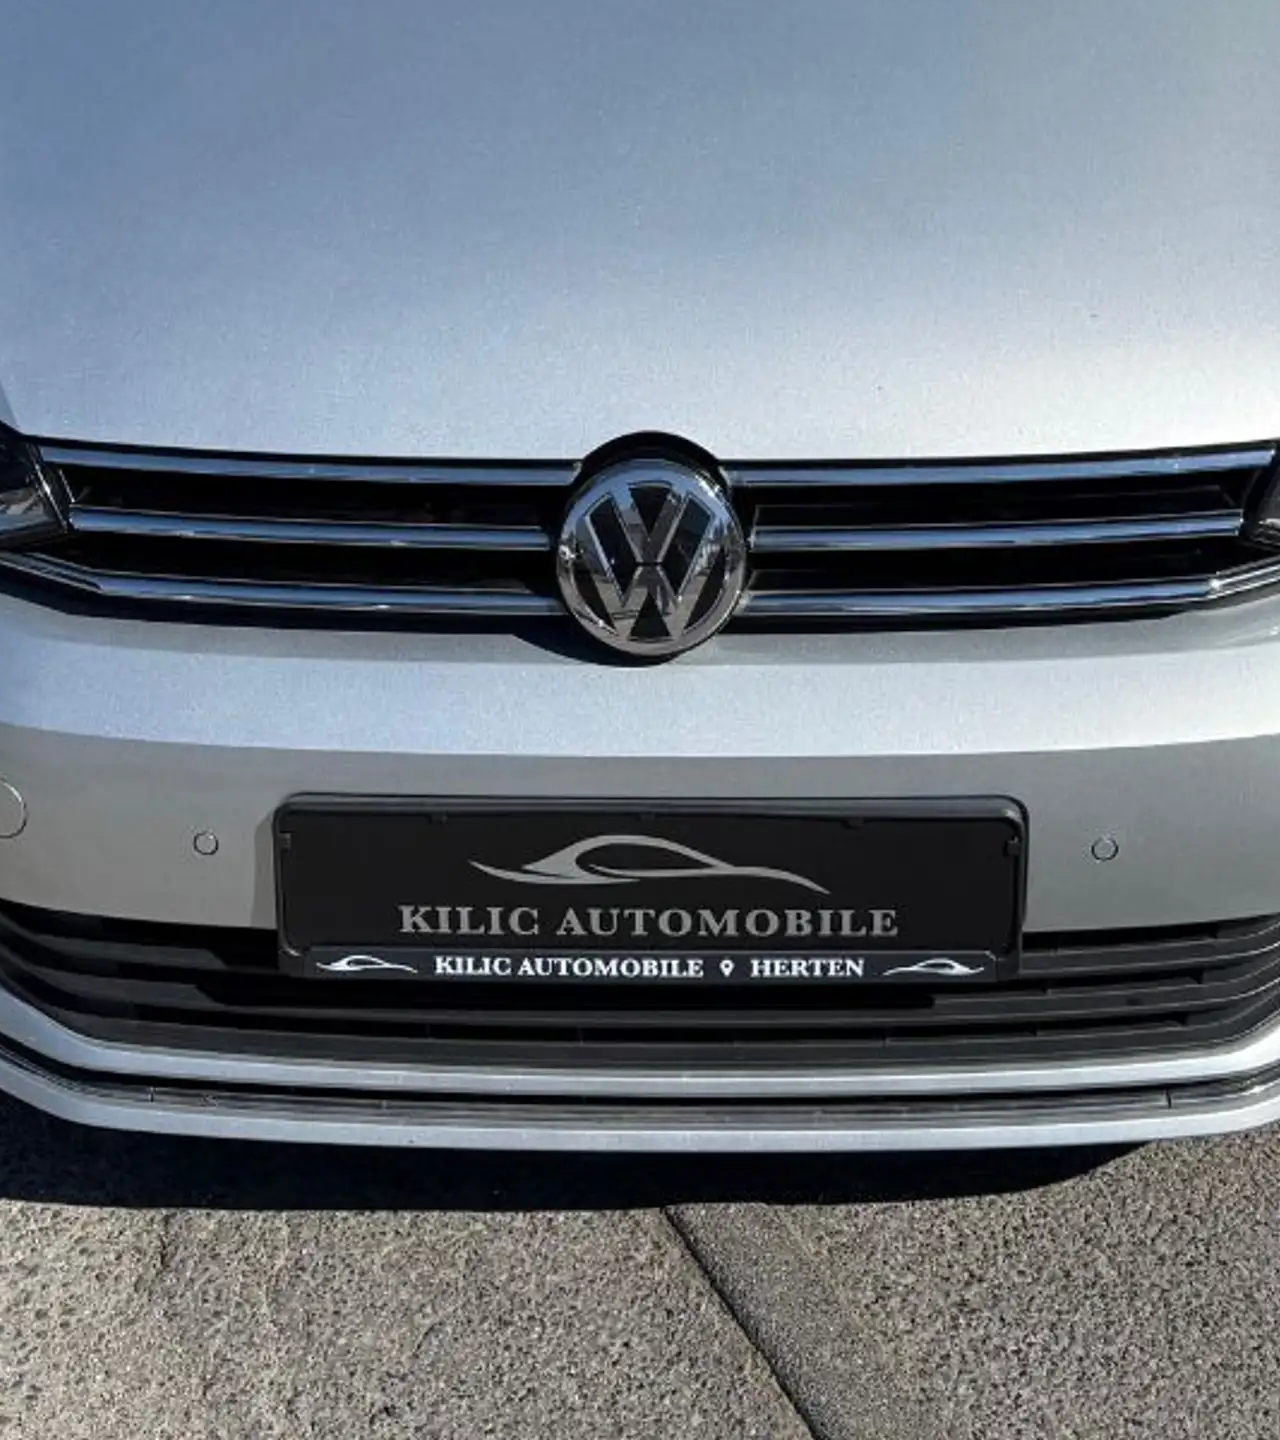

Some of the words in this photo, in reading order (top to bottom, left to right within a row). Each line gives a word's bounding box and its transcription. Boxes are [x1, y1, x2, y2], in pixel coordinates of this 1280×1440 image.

[397, 904, 540, 936] KILIC
[555, 906, 899, 937] AUTOMOBILE
[433, 955, 513, 977] KILIC
[516, 956, 705, 978] AUTOMOBILE
[749, 957, 865, 978] HERTEN
